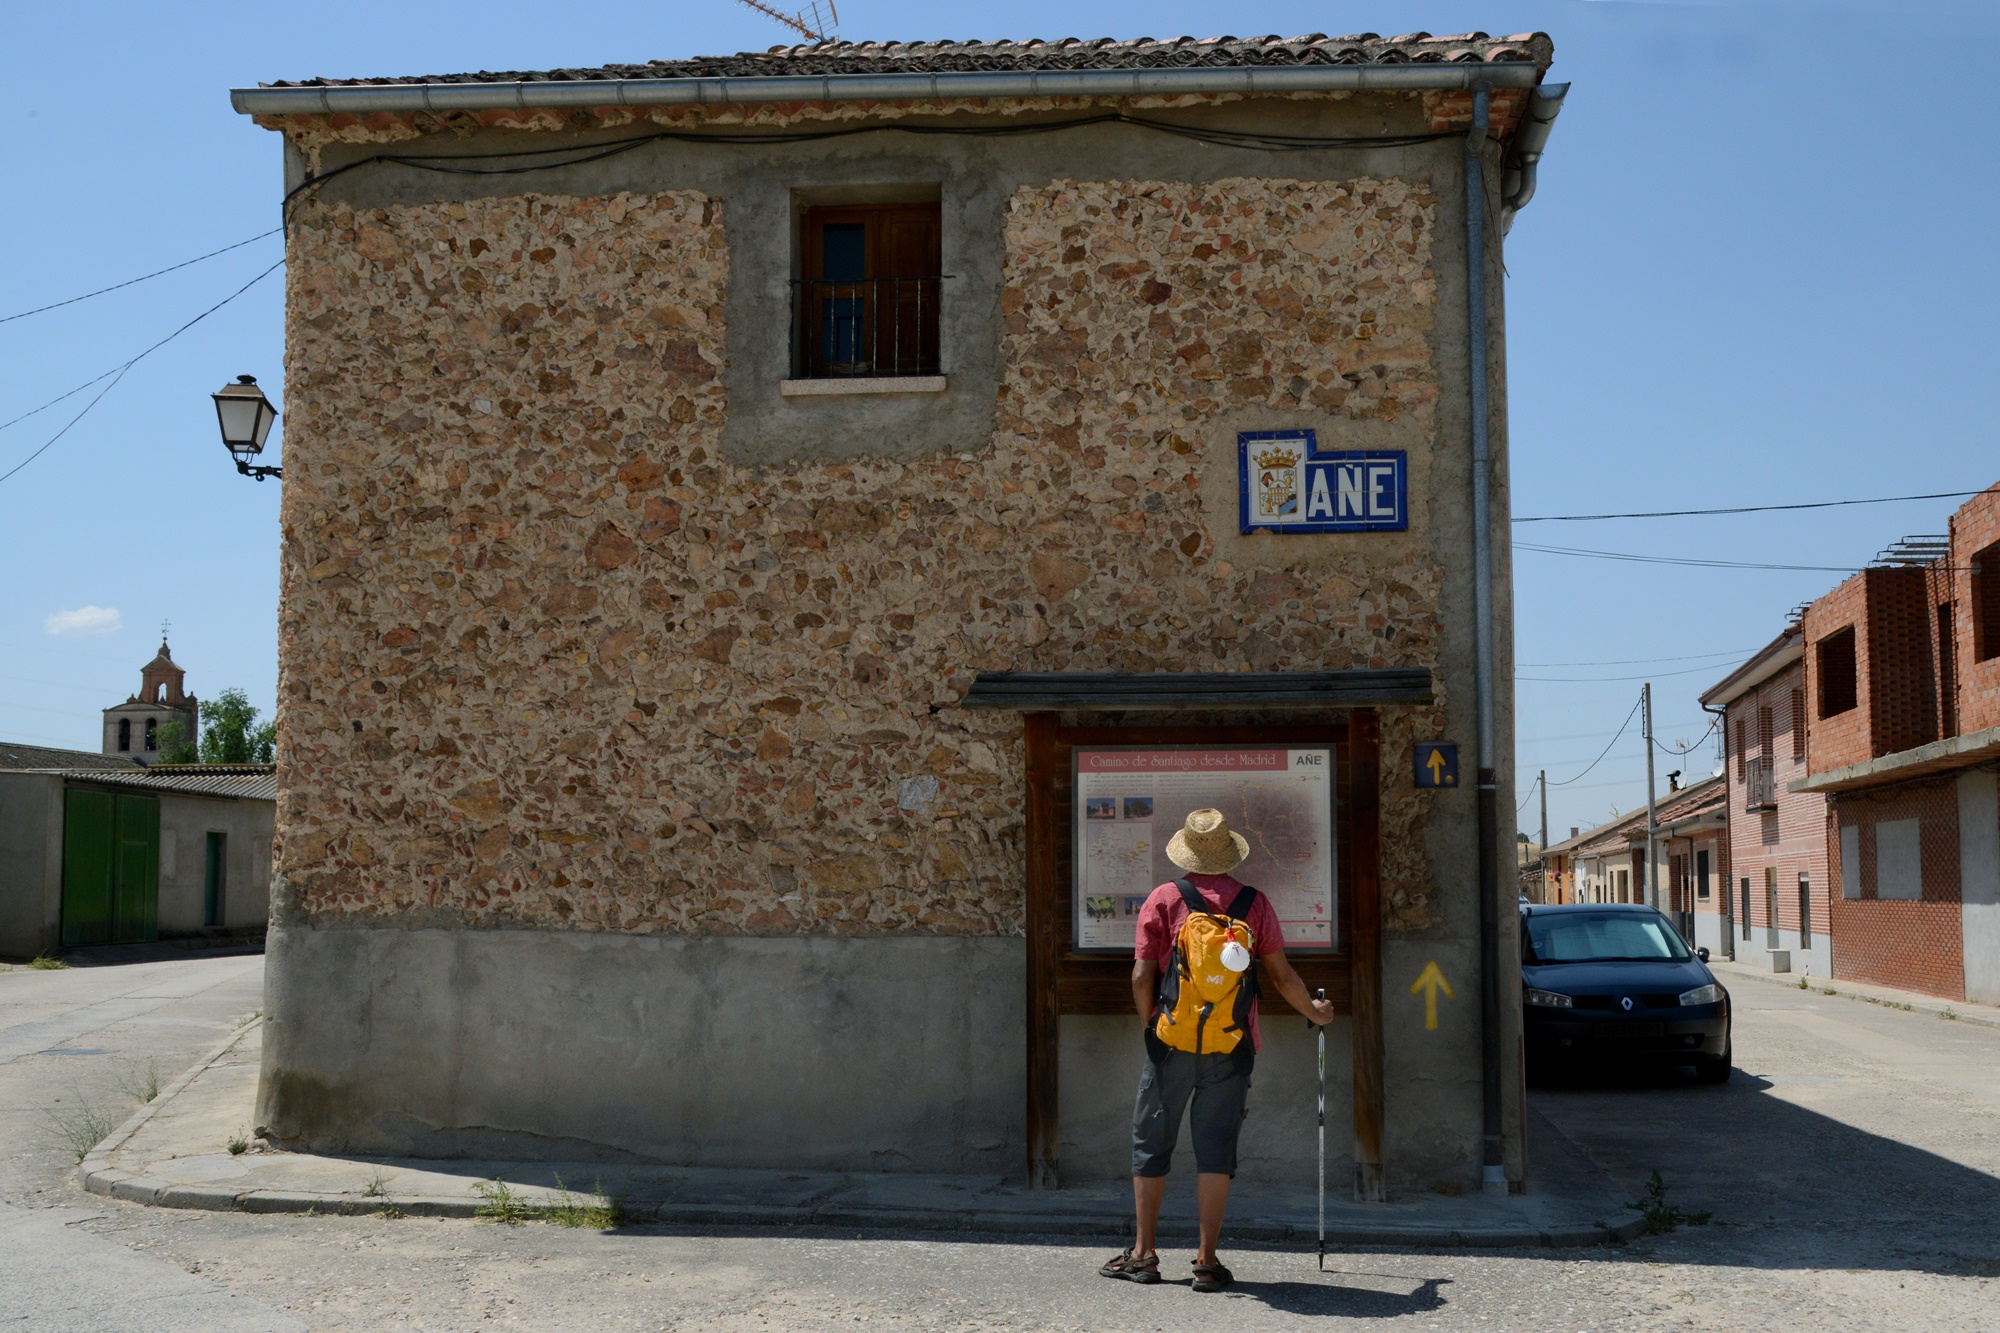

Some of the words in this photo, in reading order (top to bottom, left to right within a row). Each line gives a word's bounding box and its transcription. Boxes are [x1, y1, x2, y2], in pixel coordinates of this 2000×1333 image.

[1308, 463, 1394, 517] AÑE
[1090, 755, 1129, 767] Camino
[1132, 754, 1147, 766] de
[1150, 754, 1197, 771] Santiago
[1200, 753, 1236, 765] desde
[1239, 753, 1276, 765] Madrid
[1296, 754, 1322, 765] AÑE
